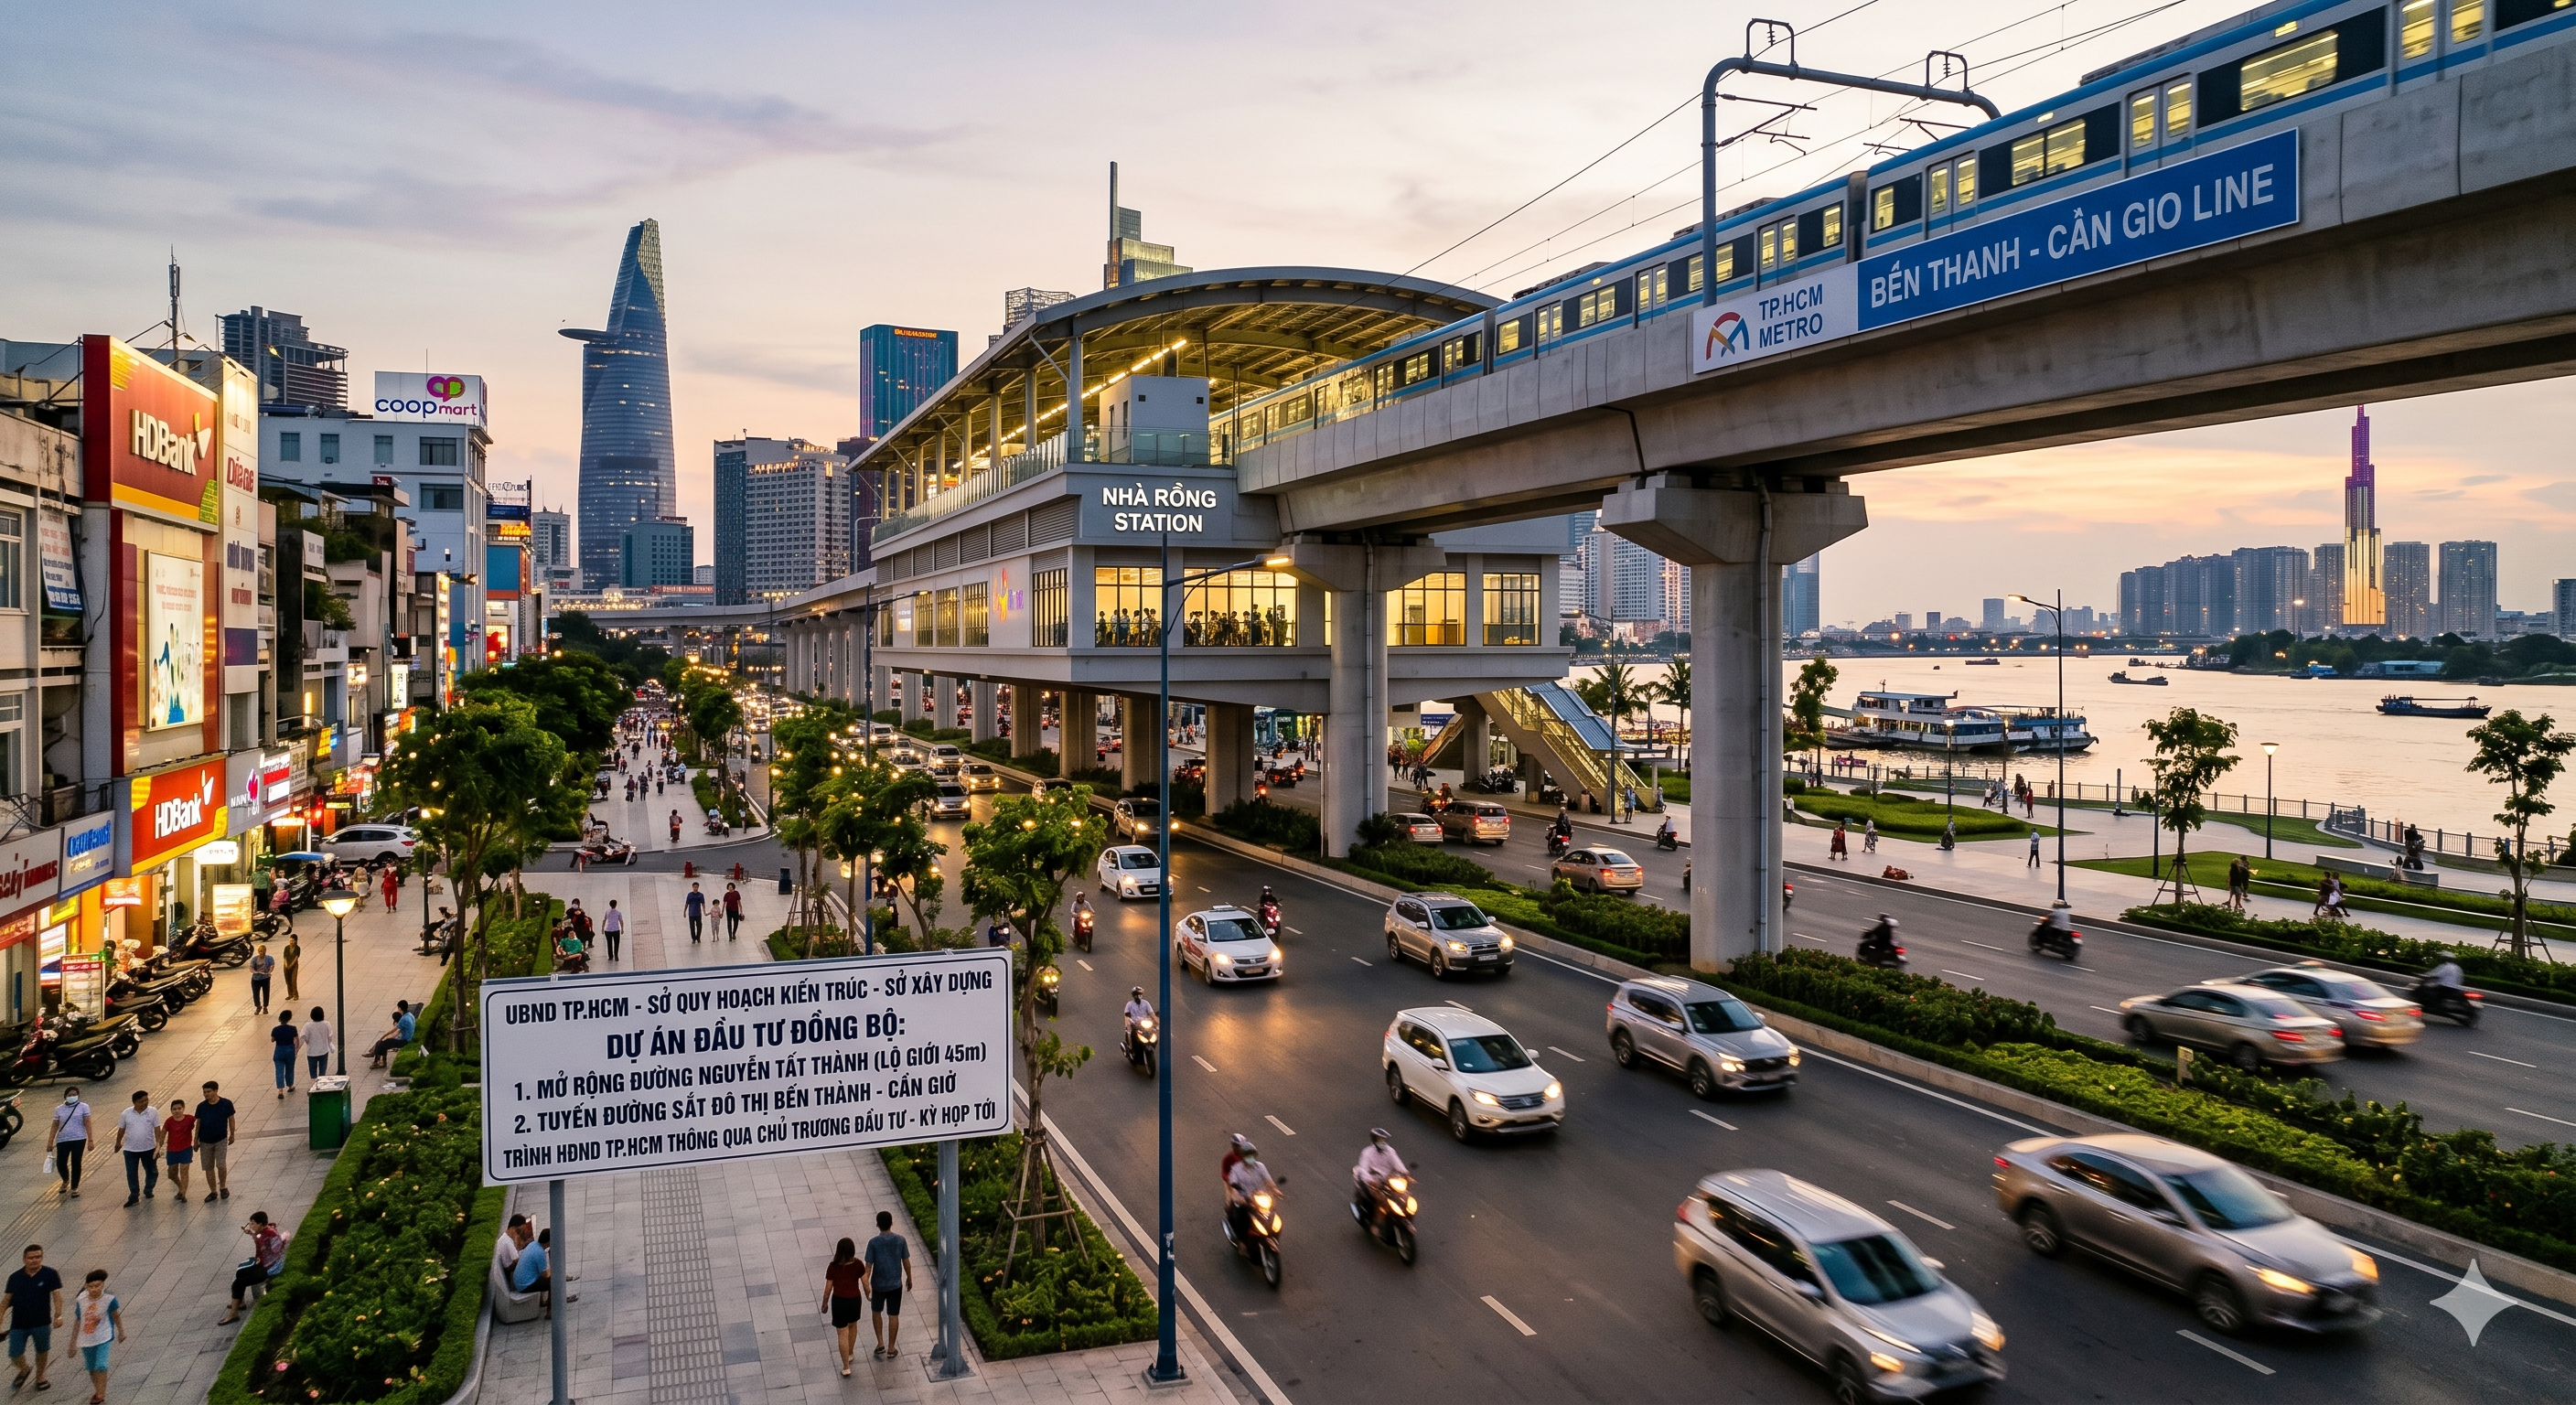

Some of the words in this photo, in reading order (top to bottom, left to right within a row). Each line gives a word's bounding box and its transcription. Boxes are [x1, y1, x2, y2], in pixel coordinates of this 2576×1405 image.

[1872, 260, 1919, 308] BẾN
[1927, 237, 2020, 292] THANH
[2122, 192, 2182, 239] GIO
[2195, 164, 2274, 221] LINE
[1759, 284, 1822, 320] TP.HCM
[1759, 313, 1822, 349] METRO
[134, 409, 197, 476] HDBank
[1102, 482, 1149, 507] NHÀ
[1154, 482, 1217, 508] RỒNG
[1114, 512, 1203, 532] STATION
[156, 792, 201, 839] HDBank
[505, 1002, 557, 1025] UBND
[562, 996, 629, 1021] TP.HCM
[647, 985, 672, 1015] SỞ
[676, 991, 712, 1015] QUY
[716, 986, 775, 1013] HOẠCH
[780, 977, 820, 1005] KIẾN
[824, 976, 868, 1002] TRÚC
[885, 969, 907, 997] SỞ
[911, 971, 943, 995] XÂY
[948, 970, 993, 995] DỰNG
[606, 1029, 645, 1065] DỰ
[649, 1024, 686, 1056] ÁN
[693, 1015, 745, 1053] ĐẦU
[752, 1018, 787, 1048] TƯ
[789, 1009, 858, 1045] ĐỒNG
[865, 1007, 906, 1043] BỘ:
[514, 1081, 531, 1101] 1.
[537, 1069, 569, 1099] MỞ
[573, 1069, 625, 1099] RỘNG
[629, 1064, 693, 1091] ĐƯỜNG
[698, 1054, 770, 1086] NGUYỄN
[775, 1051, 807, 1078] TẤT
[810, 1049, 869, 1076] THÀNH
[874, 1045, 901, 1073] (LỘ
[906, 1041, 939, 1067] GIỚI
[944, 1041, 986, 1063] 45m)
[514, 1114, 531, 1134] 2.
[537, 1101, 597, 1132] TUYẾN
[602, 1099, 667, 1126] ĐƯỜNG
[671, 1091, 706, 1120] SẮT
[711, 1091, 735, 1116] ĐÔ
[740, 1091, 768, 1116] THỊ
[774, 1082, 810, 1110] BẾN
[813, 1079, 871, 1107] THÀNH
[887, 1068, 923, 1099] CẦN
[502, 1143, 552, 1169] TRÌNH
[556, 1141, 601, 1164] HĐND
[605, 1134, 663, 1159] TP.HCM
[667, 1127, 718, 1153] THÔNG
[723, 1126, 753, 1149] QUA
[757, 1111, 788, 1143] CHỦ
[791, 1116, 851, 1140] TRƯƠNG
[854, 1108, 884, 1134] ĐẦU
[887, 1109, 907, 1131] TƯ
[919, 1103, 938, 1127] KỲ
[941, 1104, 971, 1128] HỌP
[973, 1097, 996, 1121] TỚI
